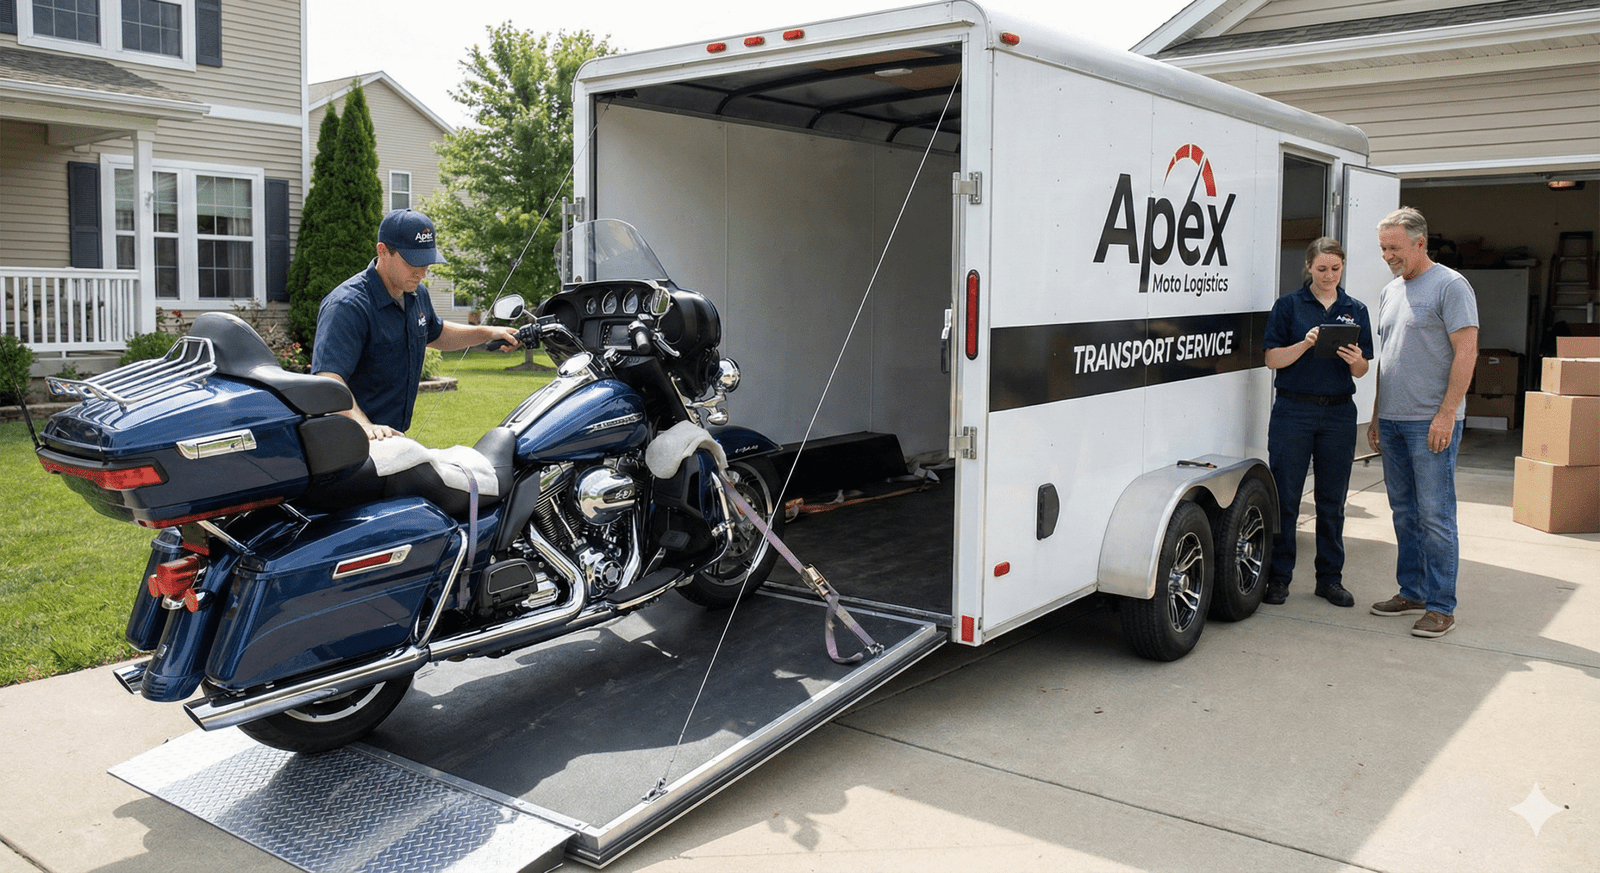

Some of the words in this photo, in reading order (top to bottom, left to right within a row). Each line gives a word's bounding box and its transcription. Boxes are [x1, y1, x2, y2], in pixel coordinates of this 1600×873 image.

[1093, 173, 1236, 293] Apex
[1152, 274, 1181, 293] Moto
[1184, 272, 1229, 297] Logistics
[1073, 337, 1174, 374] TRANSPORT
[1176, 331, 1233, 362] SERVICE
